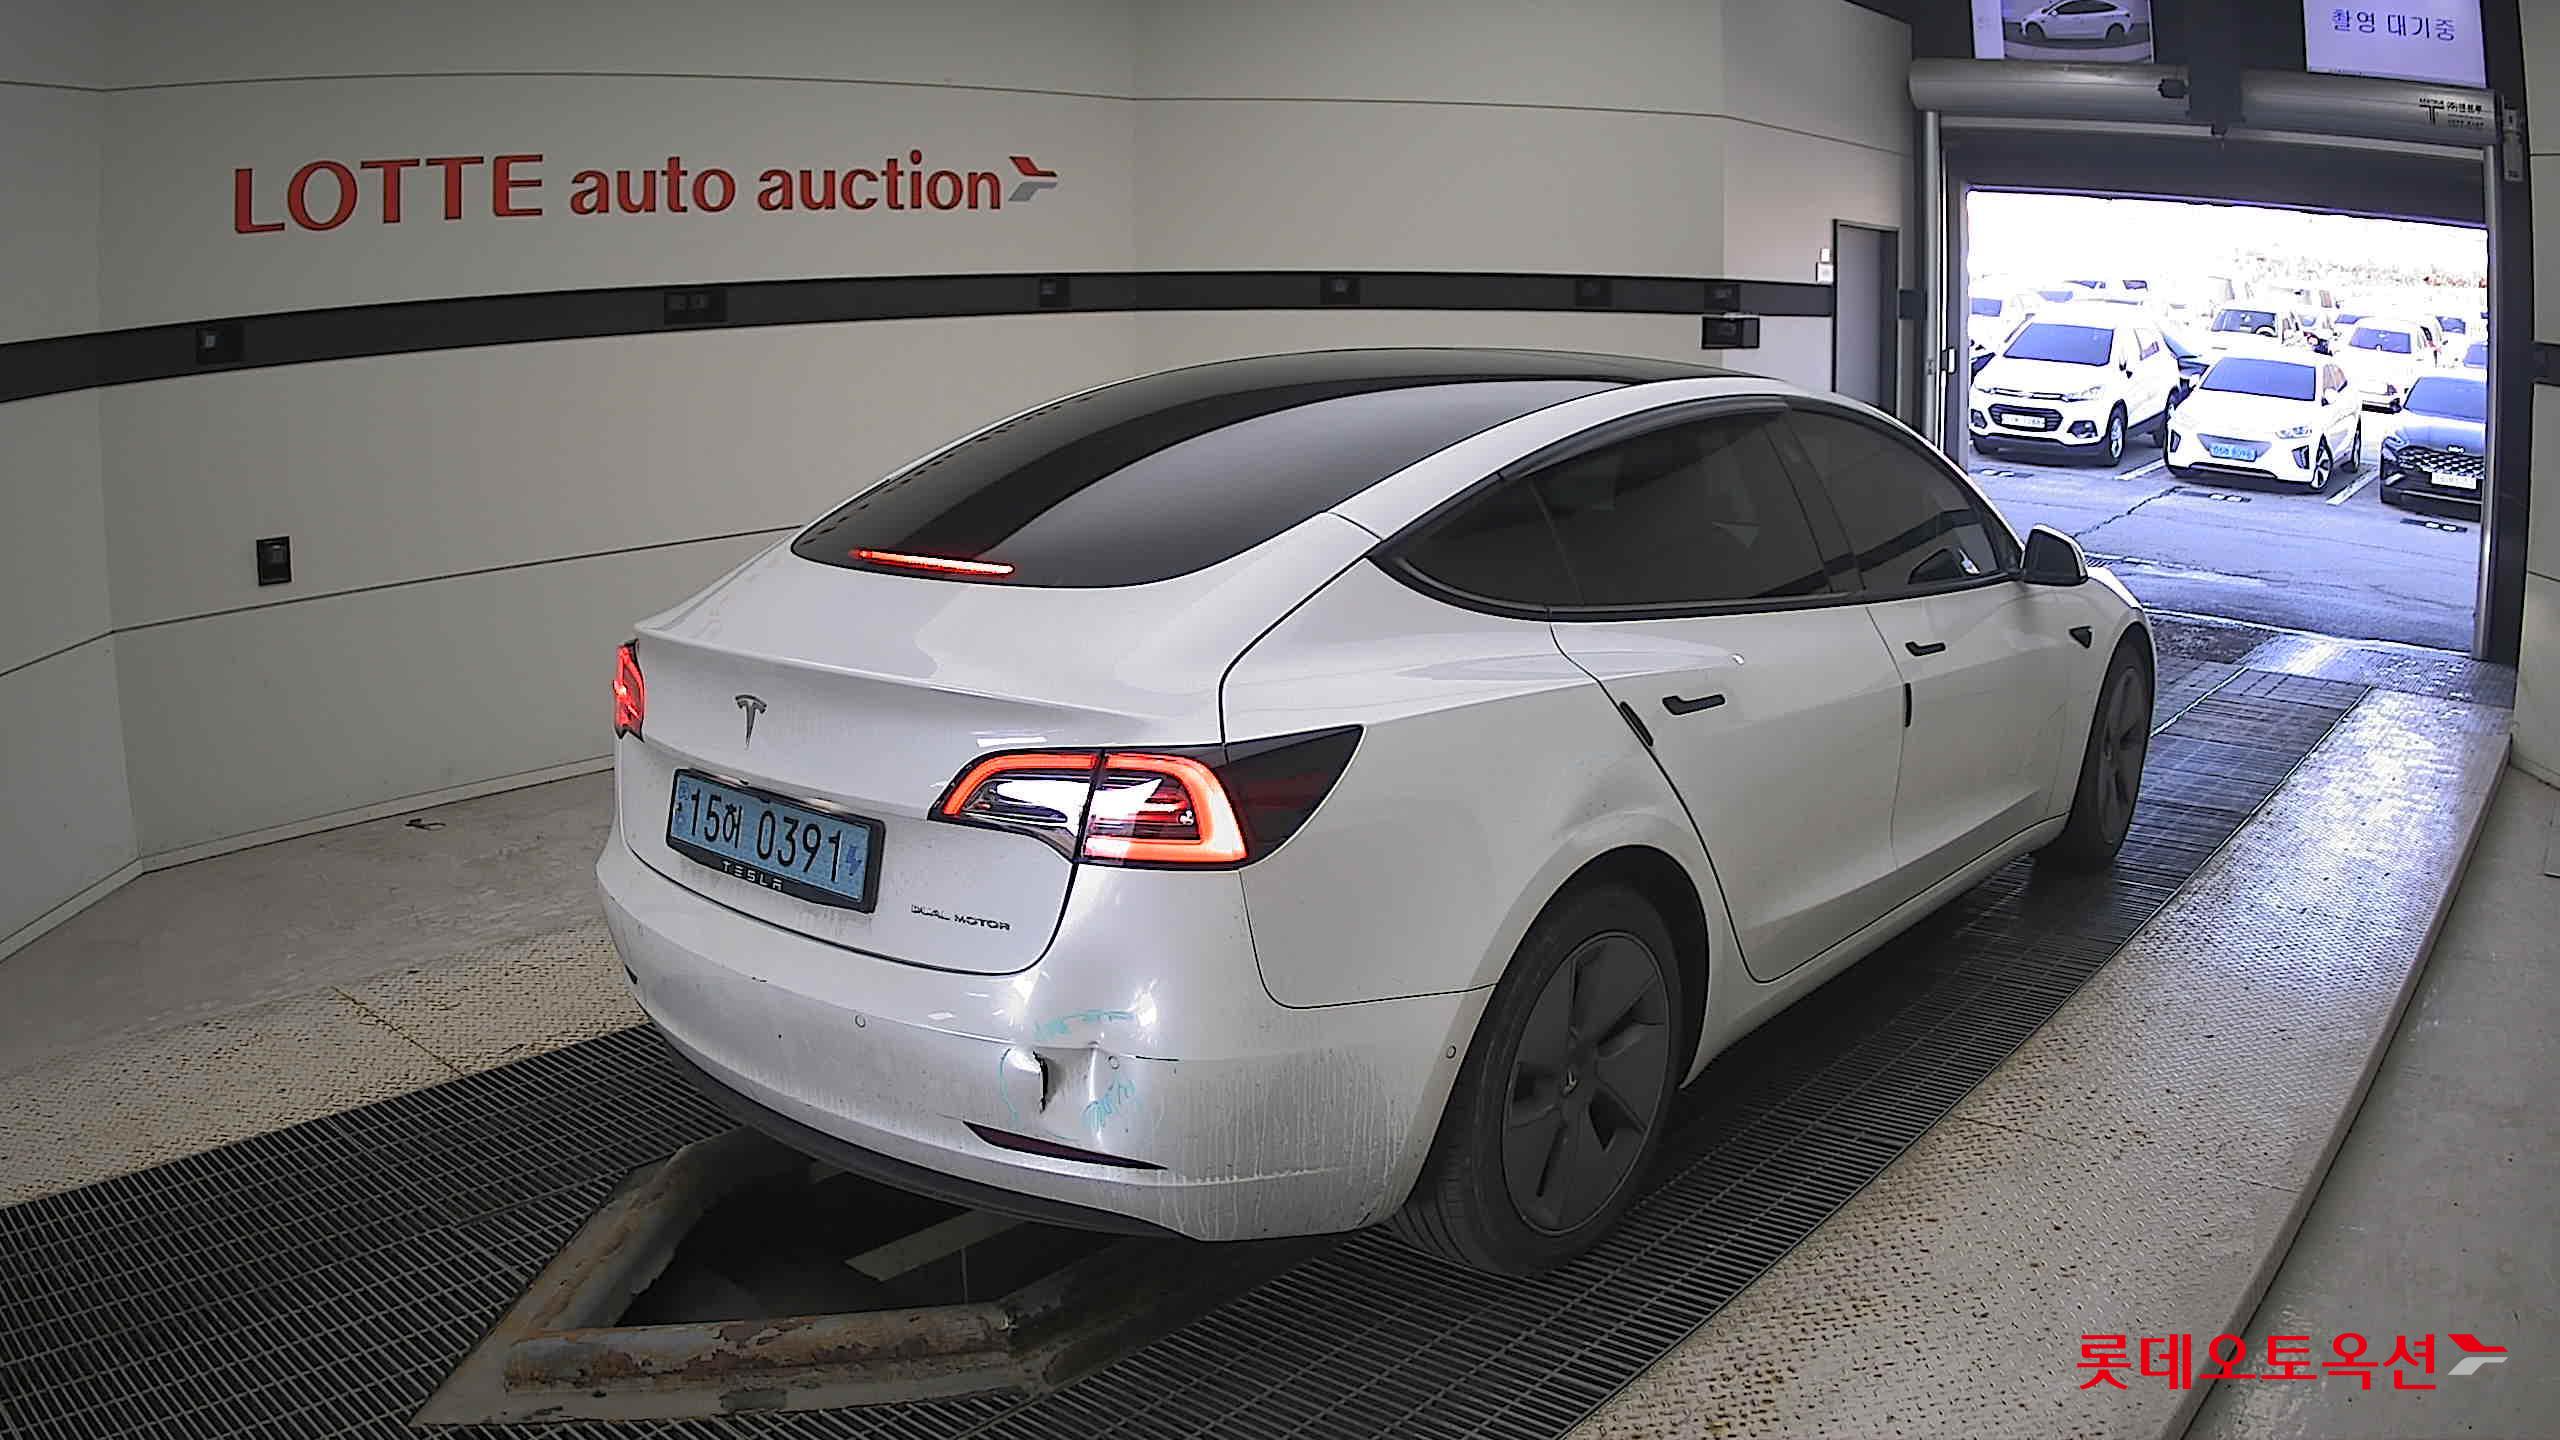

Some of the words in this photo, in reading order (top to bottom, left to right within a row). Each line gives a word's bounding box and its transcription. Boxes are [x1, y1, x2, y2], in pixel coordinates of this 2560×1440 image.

[2387, 14, 2456, 42] 대기중
[234, 153, 544, 235] LOTTE
[570, 155, 736, 215] auto
[757, 149, 1001, 212] auction
[691, 788, 743, 849] 15허
[756, 810, 842, 882] 0391
[721, 860, 784, 891] TESLA
[953, 914, 1010, 931] MOTOR
